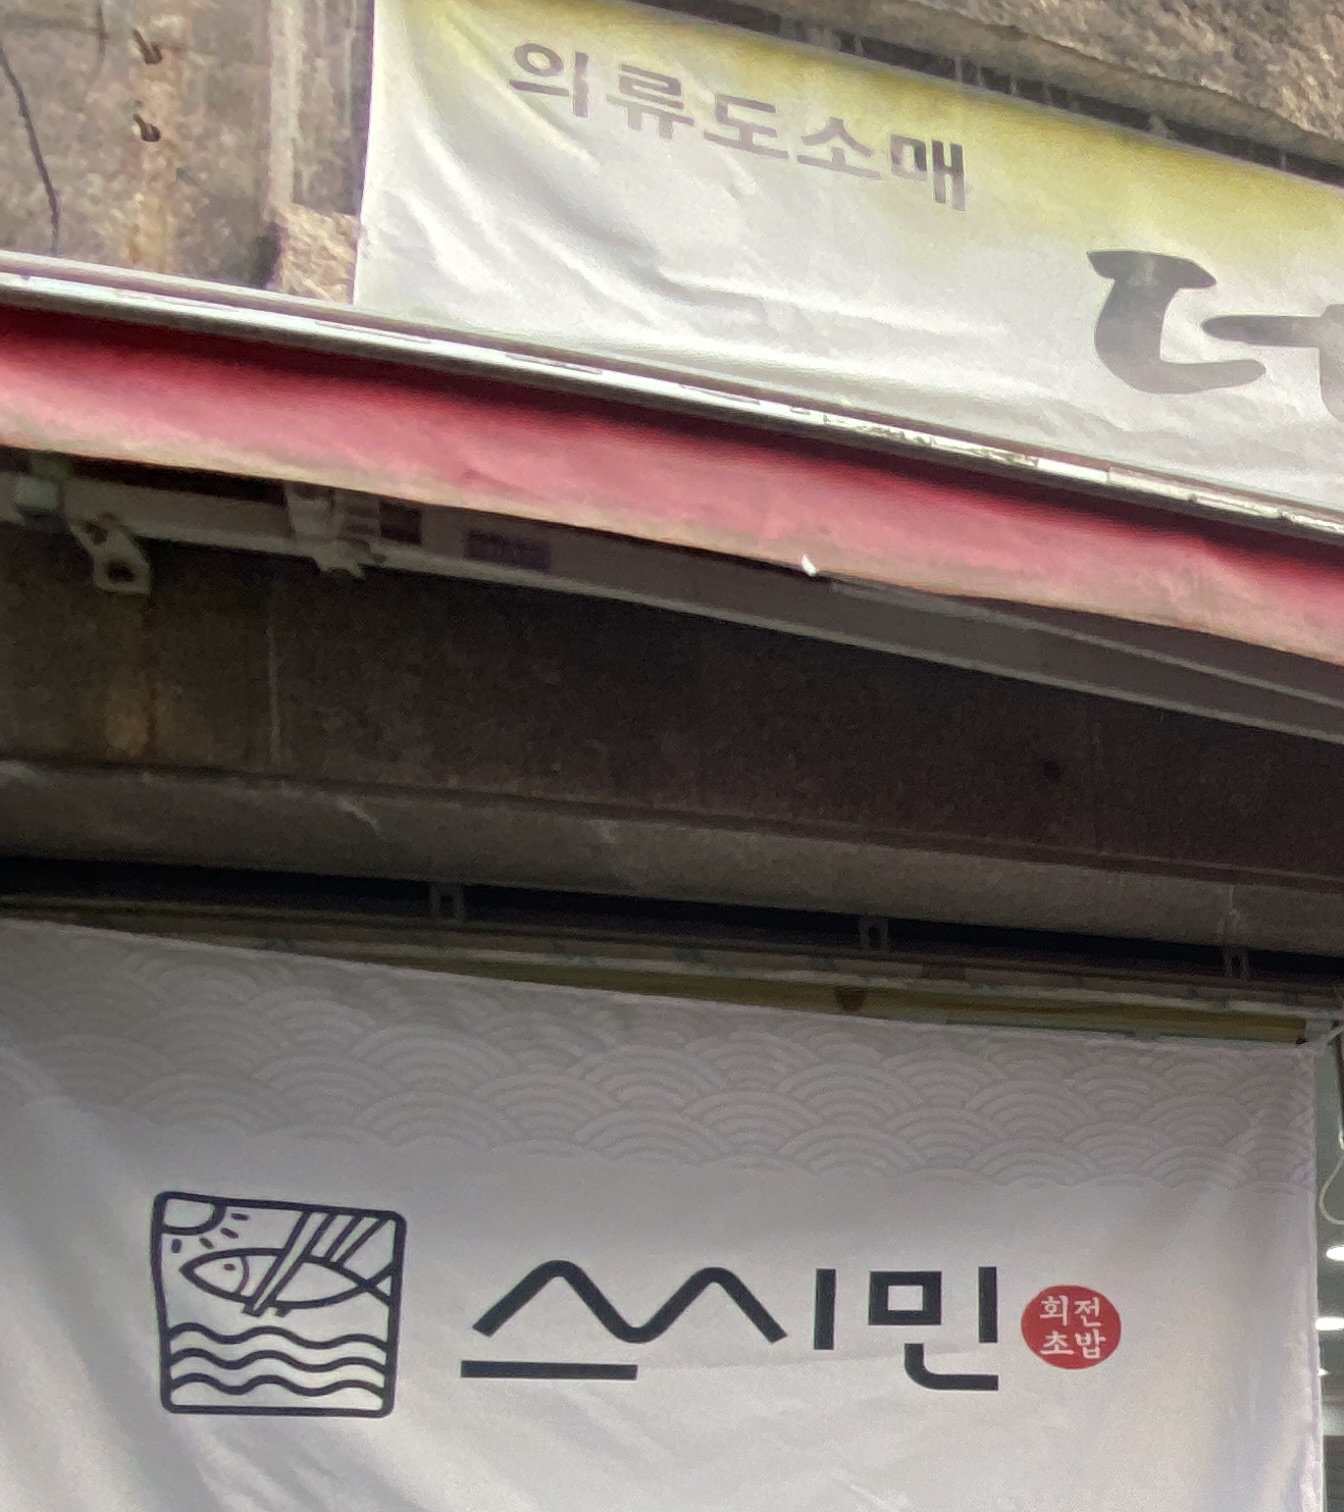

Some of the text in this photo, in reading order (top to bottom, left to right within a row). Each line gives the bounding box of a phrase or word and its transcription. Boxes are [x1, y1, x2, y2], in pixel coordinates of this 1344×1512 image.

[509, 41, 965, 211] 의류도소매
[1039, 1295, 1104, 1328] 회전
[1039, 1328, 1107, 1360] 초밥
